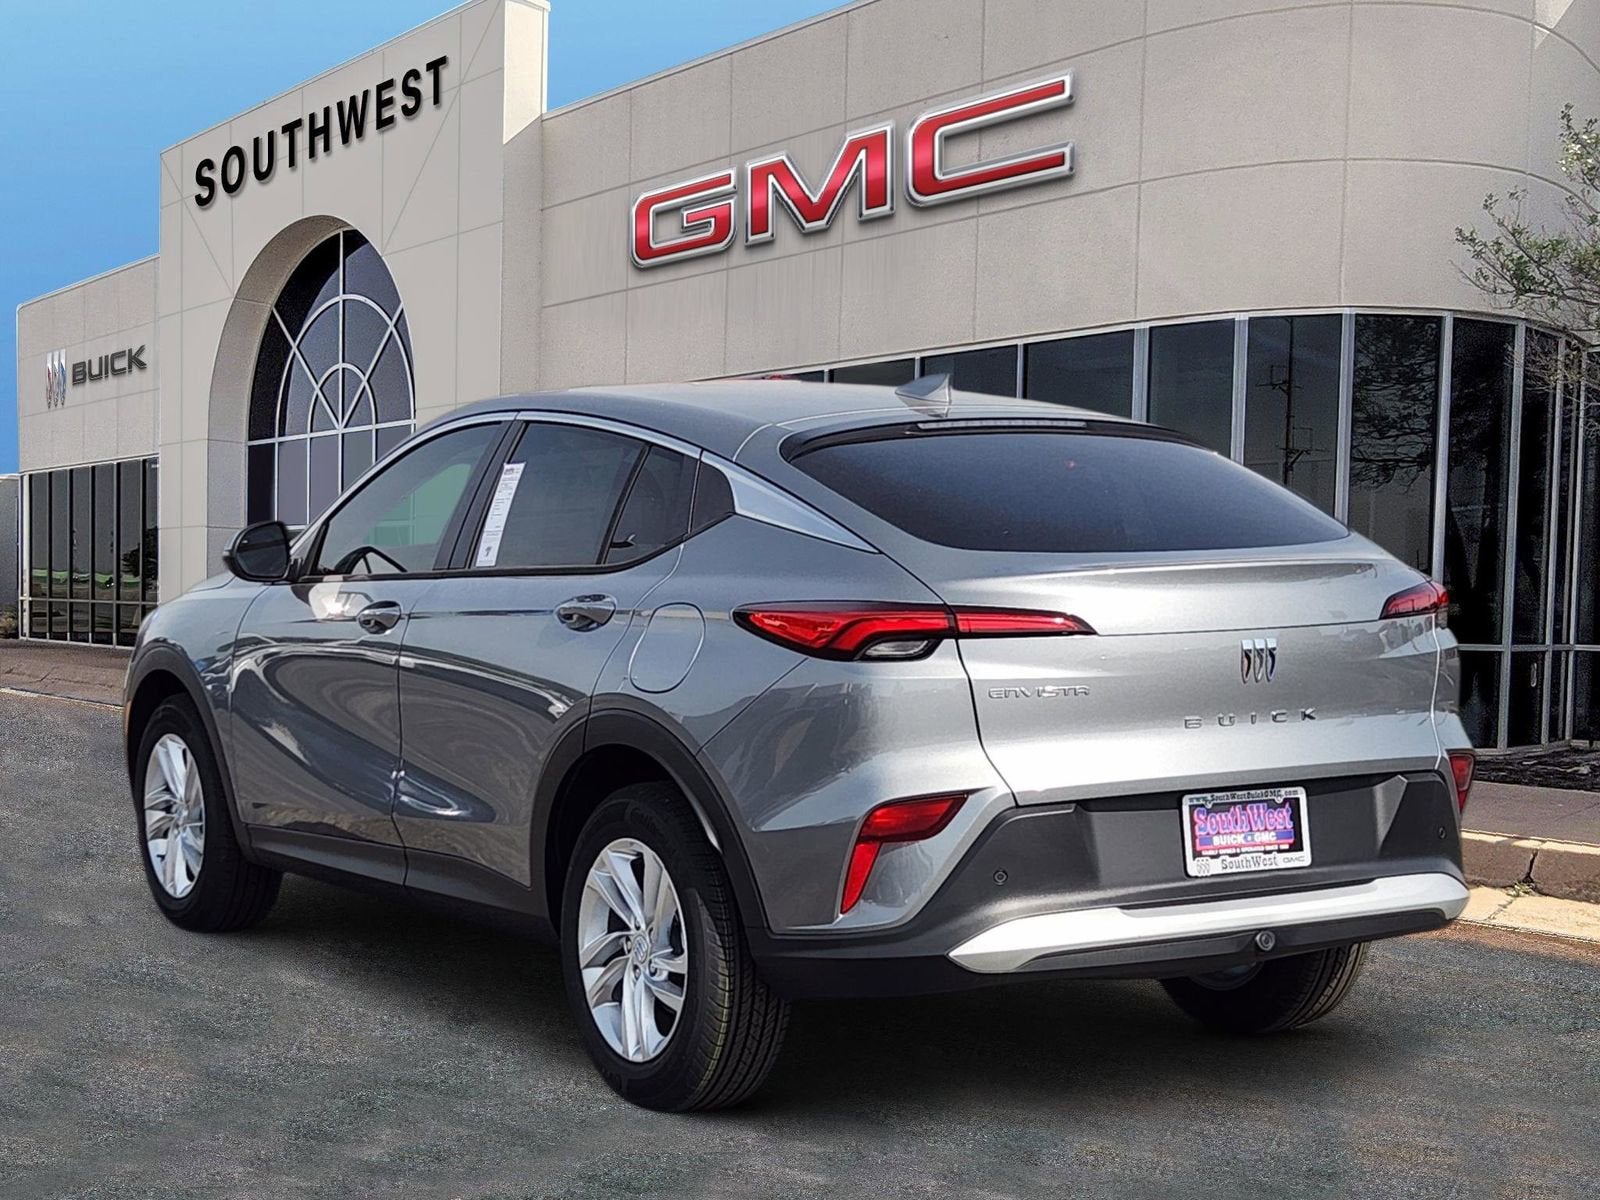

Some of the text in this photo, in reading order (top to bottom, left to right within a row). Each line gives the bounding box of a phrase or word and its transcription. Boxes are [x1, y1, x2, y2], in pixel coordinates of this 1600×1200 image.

[195, 55, 448, 207] SOUTHWEST
[630, 70, 1075, 268] GMC
[72, 344, 147, 386] BUICK
[1184, 708, 1316, 729] BUICK
[1194, 802, 1294, 836] SouthWest
[1212, 831, 1277, 846] BUICK GMC
[1221, 855, 1279, 870] SouthWest
